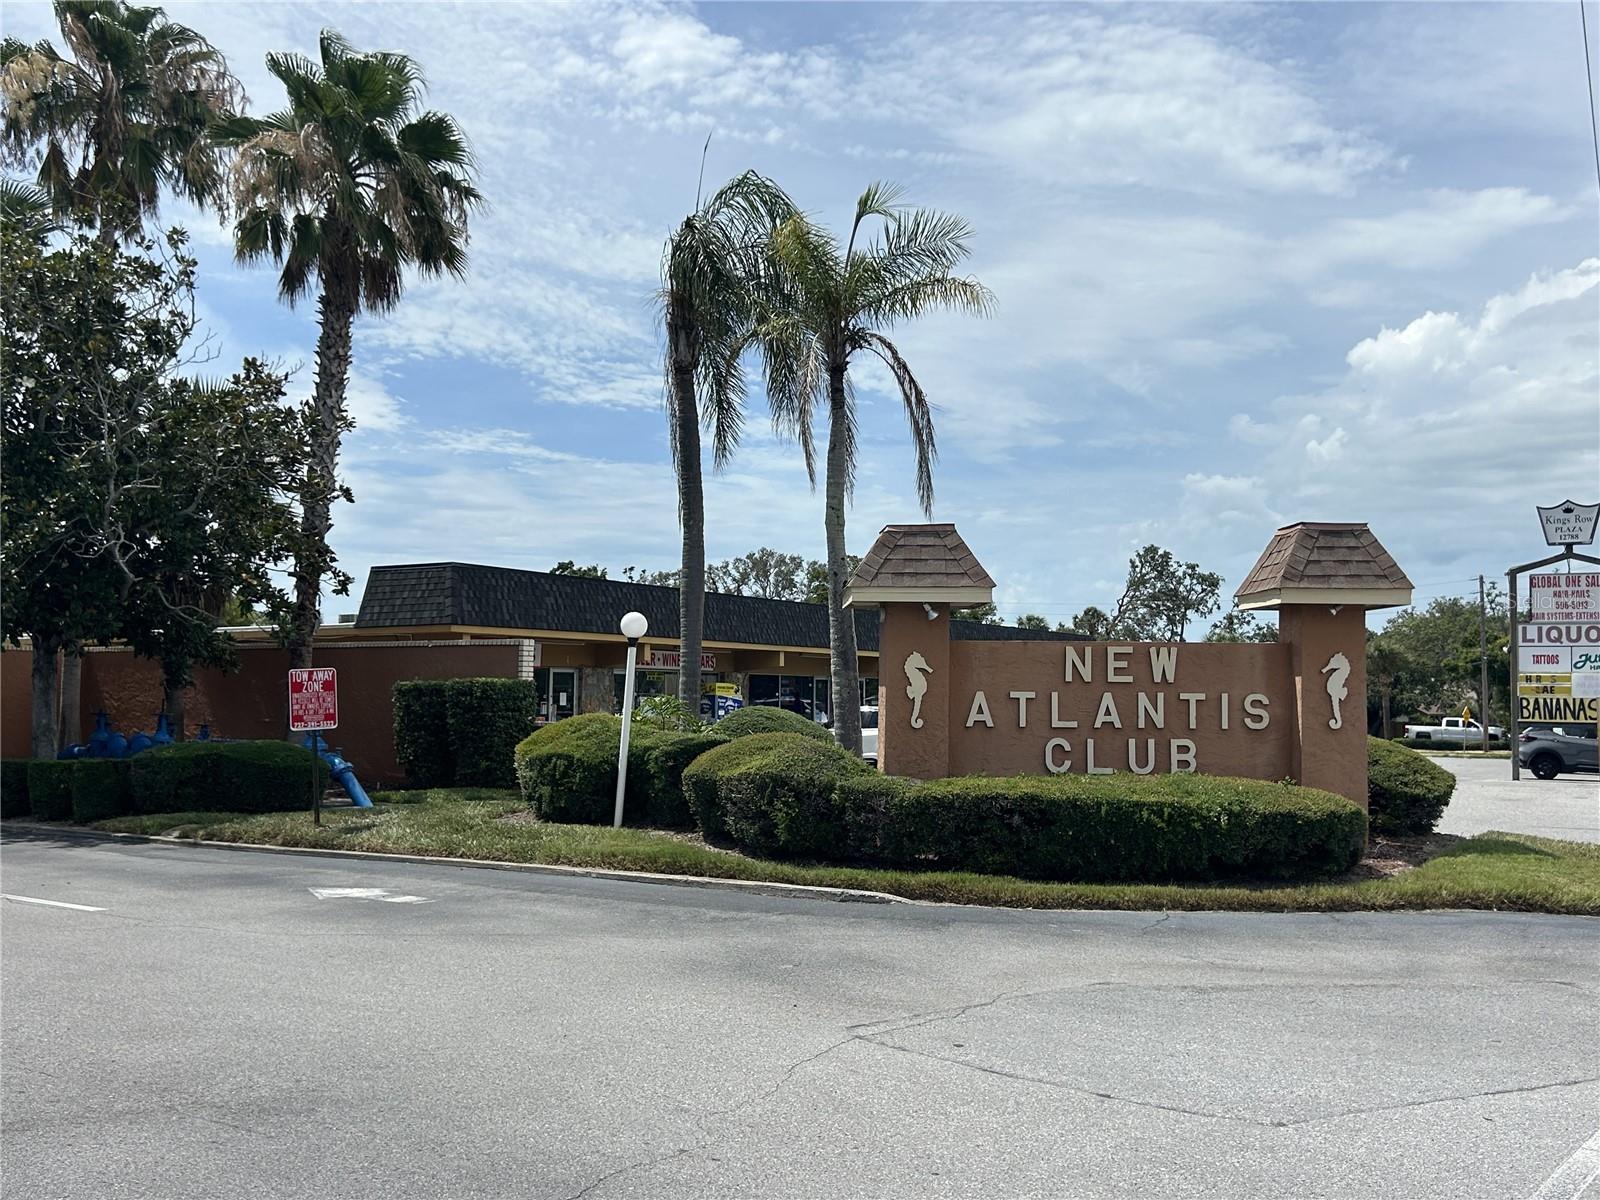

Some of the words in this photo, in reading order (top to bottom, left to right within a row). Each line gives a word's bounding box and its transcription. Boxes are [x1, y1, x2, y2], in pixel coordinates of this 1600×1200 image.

[1545, 515, 1570, 525] Kings
[1575, 514, 1593, 523] Row
[1531, 576, 1561, 588] GLOBAL
[1565, 575, 1581, 587] ONE
[1522, 625, 1600, 644] LIQUO
[1065, 646, 1178, 683] NEW
[1532, 654, 1559, 665] TATTOOS
[292, 671, 308, 682] TOW
[312, 670, 333, 681] AWAY
[302, 681, 324, 692] ZONE
[966, 691, 1270, 730] ATLANTIS
[1520, 697, 1597, 720] BANANAS
[1045, 737, 1197, 775] CLUB
